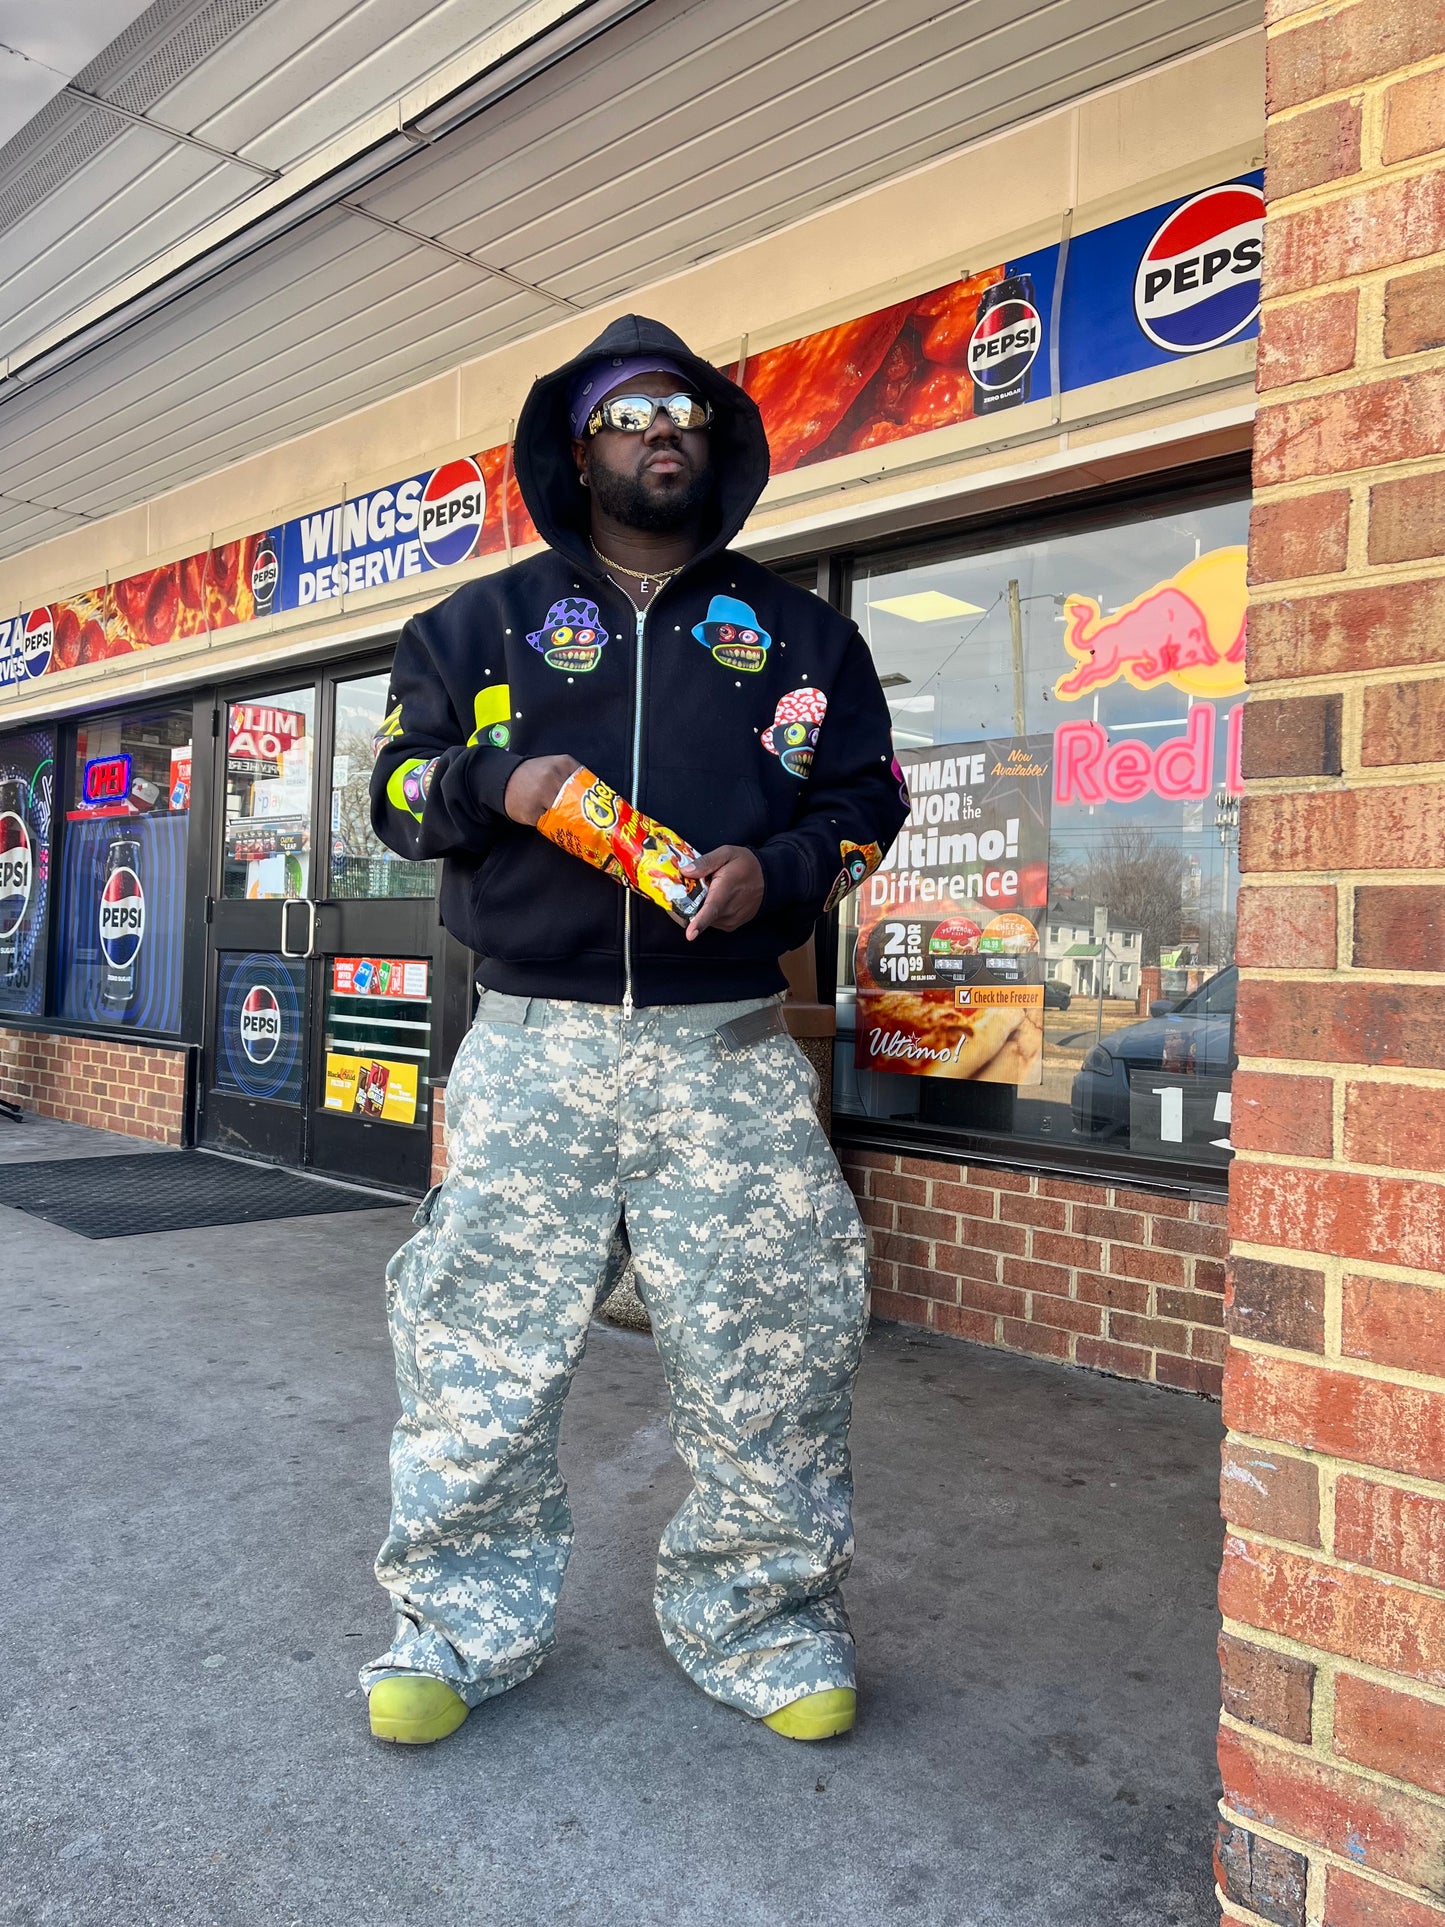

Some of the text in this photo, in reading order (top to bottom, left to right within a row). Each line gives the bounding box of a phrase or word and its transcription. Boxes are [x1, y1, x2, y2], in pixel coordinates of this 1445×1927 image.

[1144, 238, 1264, 304] PEPS
[973, 326, 1036, 362] PEPSI
[984, 387, 1021, 403] ZERO SUGAR
[300, 480, 423, 563] WINGS
[423, 492, 481, 531] PEPSI
[253, 566, 276, 584] PEPSI
[298, 539, 422, 605] DESERVE
[640, 581, 649, 592] E
[25, 631, 52, 652] PEPSI
[0, 656, 25, 680] VES
[1007, 749, 1033, 762] Now
[1053, 702, 1216, 807] Red
[87, 760, 128, 798] OPEN
[901, 753, 986, 793] TIMATE
[990, 762, 1048, 776] Available!
[963, 793, 973, 806] is
[962, 806, 981, 820] the
[870, 869, 1018, 906] Difference
[103, 908, 142, 928] PEPSI
[996, 923, 1025, 932] CHEESE
[884, 923, 921, 955] 2 FOR
[974, 991, 1039, 1003] Check the Freezer
[243, 1015, 278, 1034] PEPSI
[869, 1027, 966, 1063] Ultimo!
